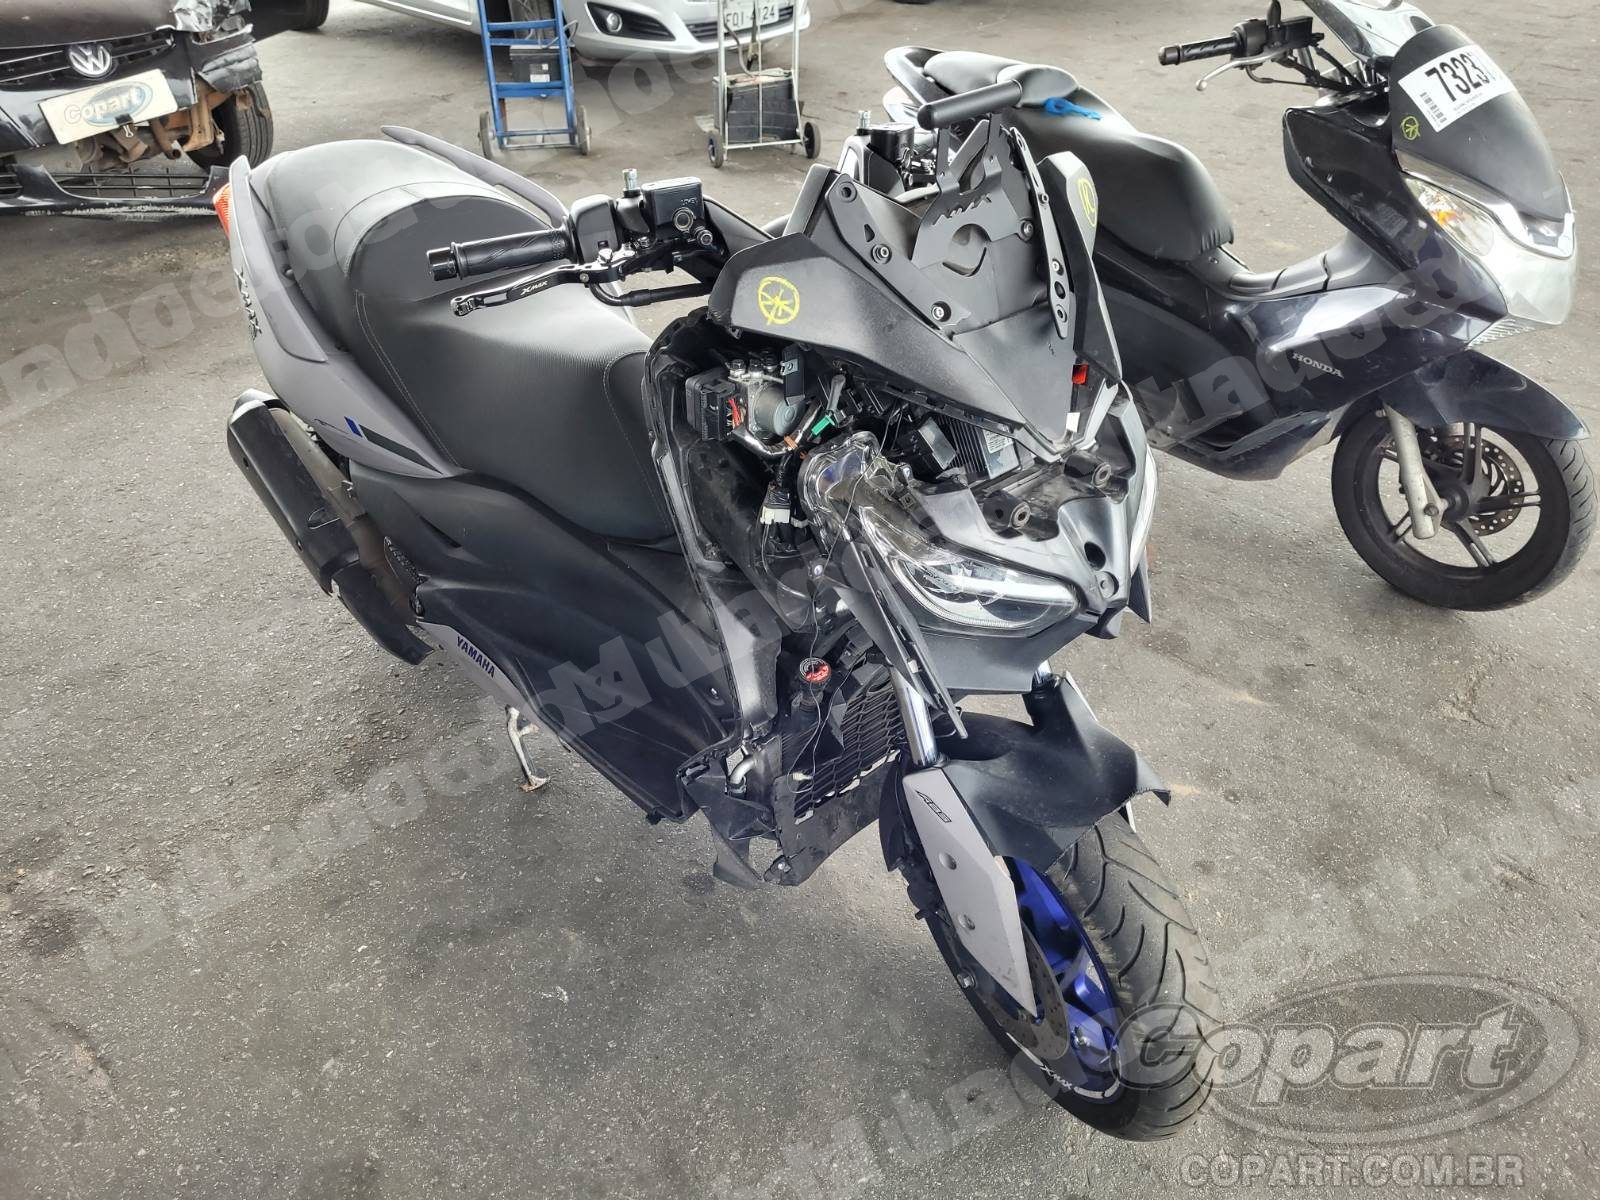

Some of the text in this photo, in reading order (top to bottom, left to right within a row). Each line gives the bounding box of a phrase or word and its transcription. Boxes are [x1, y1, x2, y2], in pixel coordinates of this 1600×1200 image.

[64, 85, 142, 125] Copart
[1292, 352, 1345, 380] HONDA
[456, 635, 495, 679] YAMAHA
